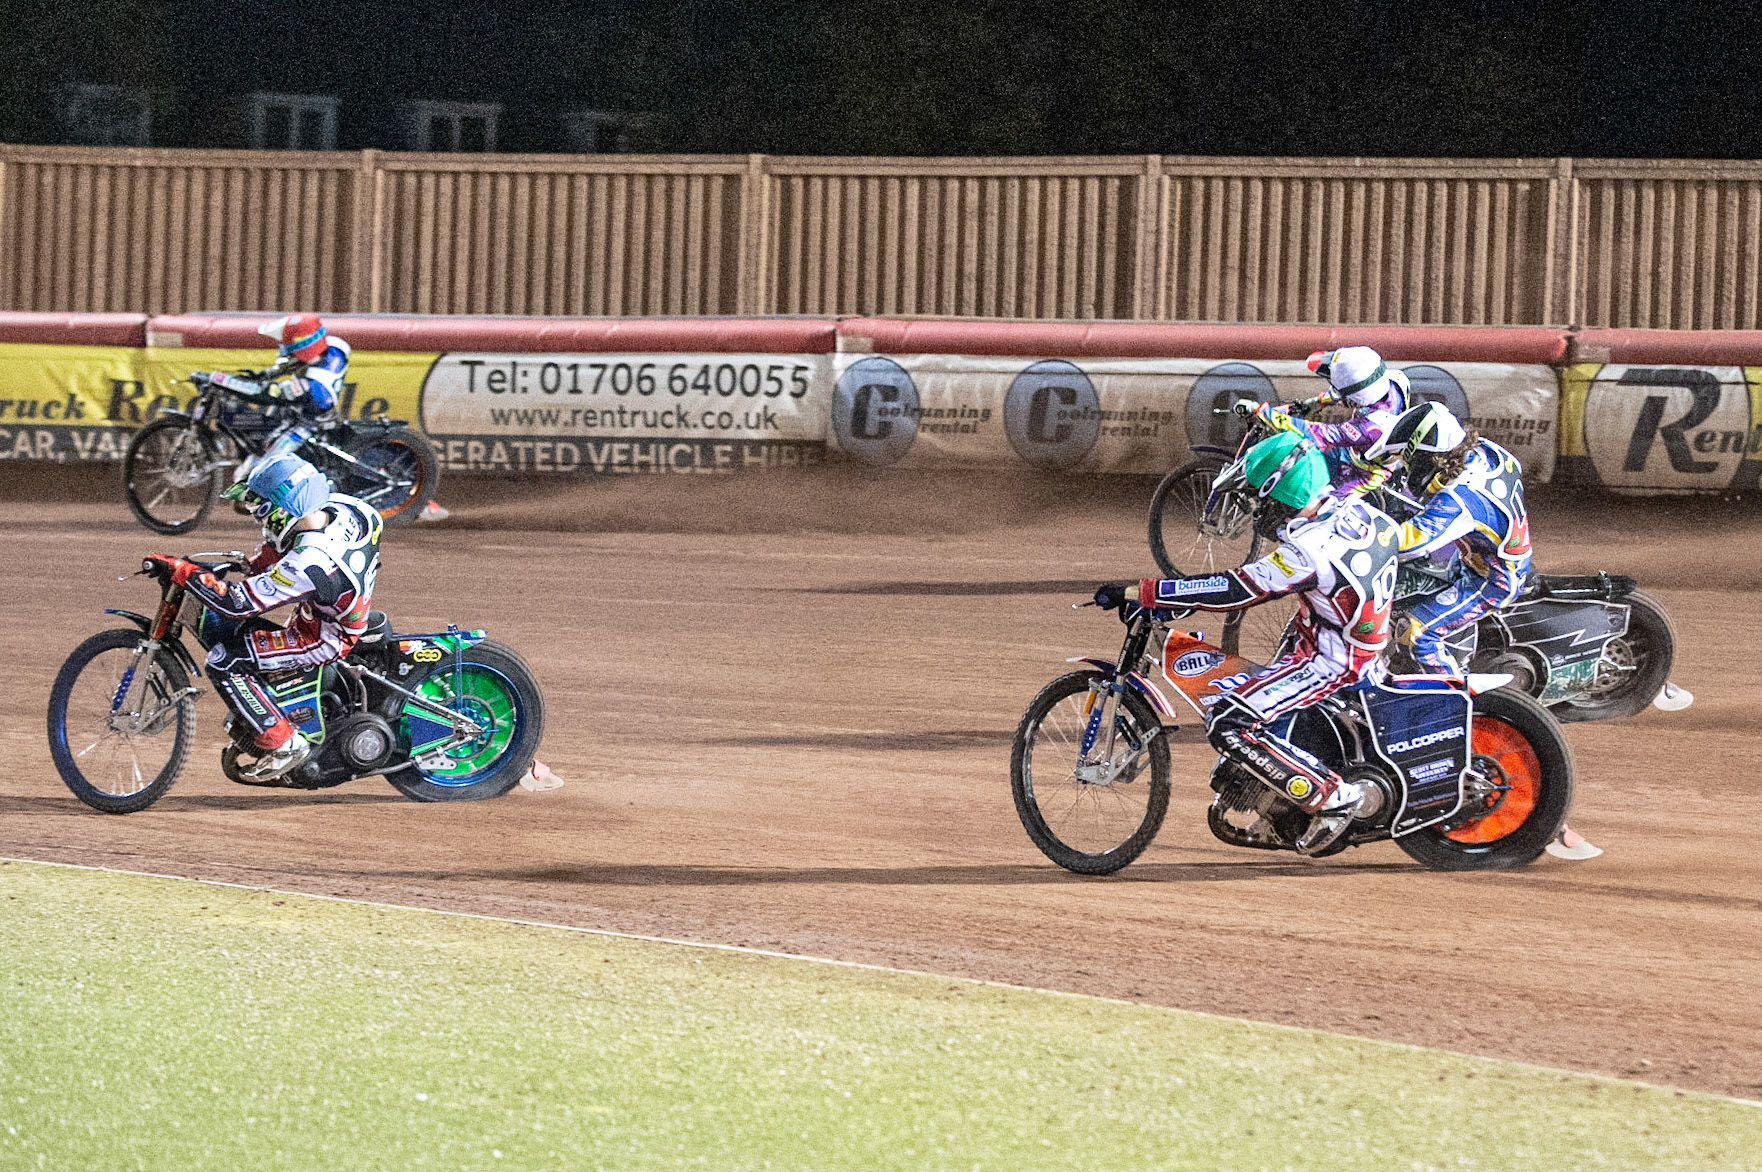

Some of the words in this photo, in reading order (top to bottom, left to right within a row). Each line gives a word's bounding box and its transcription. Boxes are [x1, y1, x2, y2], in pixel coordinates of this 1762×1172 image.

[459, 360, 527, 394] Tel:
[540, 362, 656, 396] 01706
[668, 364, 809, 398] 640055
[491, 404, 779, 430] www.rentruck.co.uk
[588, 442, 731, 474] VEHICLE
[1178, 577, 1227, 590] burnside
[1386, 726, 1465, 755] POLCOPPER
